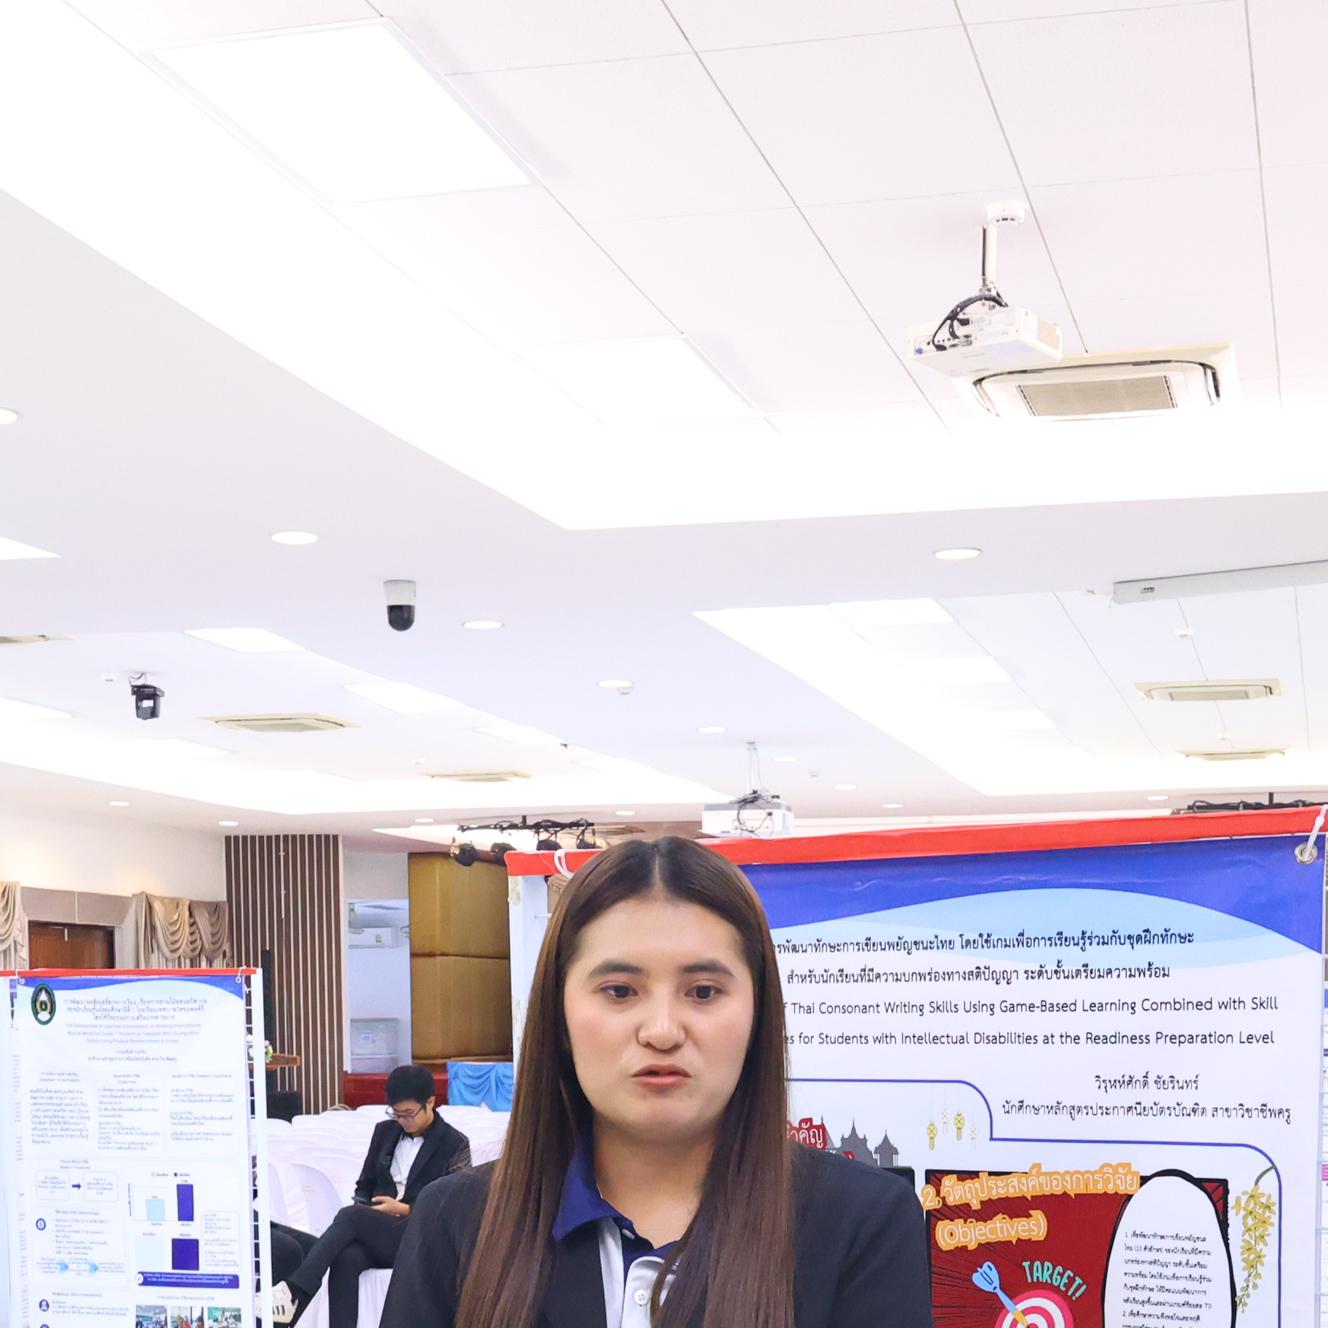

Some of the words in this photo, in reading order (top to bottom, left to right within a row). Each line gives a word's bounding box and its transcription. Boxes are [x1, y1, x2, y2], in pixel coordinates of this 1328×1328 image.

[773, 934, 955, 955] ารพัฒนาทักษะการเขียนพยัญชนะไทย
[787, 964, 1019, 985] สำหรับนักเรียนที่มีความบกพร่องทางสติปัญญา
[1023, 959, 1170, 981] ระดับชั้นเตรียมความพร้อม
[791, 1002, 815, 1014] Thai
[819, 1002, 880, 1014] Consonant
[884, 1002, 925, 1016] Writing
[929, 1001, 959, 1013] Skills
[963, 1000, 995, 1016] Using
[999, 999, 1077, 1013] Game-Based
[1082, 999, 1136, 1015] Learning
[1141, 997, 1213, 1012] Combined
[1217, 997, 1246, 1010] with
[1251, 996, 1278, 1010] Skill
[798, 1032, 815, 1045] for
[818, 1032, 869, 1045] Students
[872, 1032, 897, 1045] with
[901, 1032, 969, 1045] Intellectual
[973, 1031, 1038, 1045] Disabilities
[1042, 1033, 1056, 1044] at
[1060, 1032, 1081, 1044] the
[1085, 1032, 1150, 1045] Readiness
[1155, 1031, 1234, 1047] Preparation
[1239, 1030, 1274, 1044] Level
[1002, 1100, 1208, 1122] นักศึกษาหลักสูตรประกาศนียบัตรบัณฑิต
[1212, 1104, 1291, 1124] สาขาวิชาชีพครู
[943, 1167, 1138, 1204] วัตถุประสงค์ของการวิจัย
[937, 1216, 1045, 1246] (Objectives)
[1022, 1261, 1087, 1300] TARGET!
